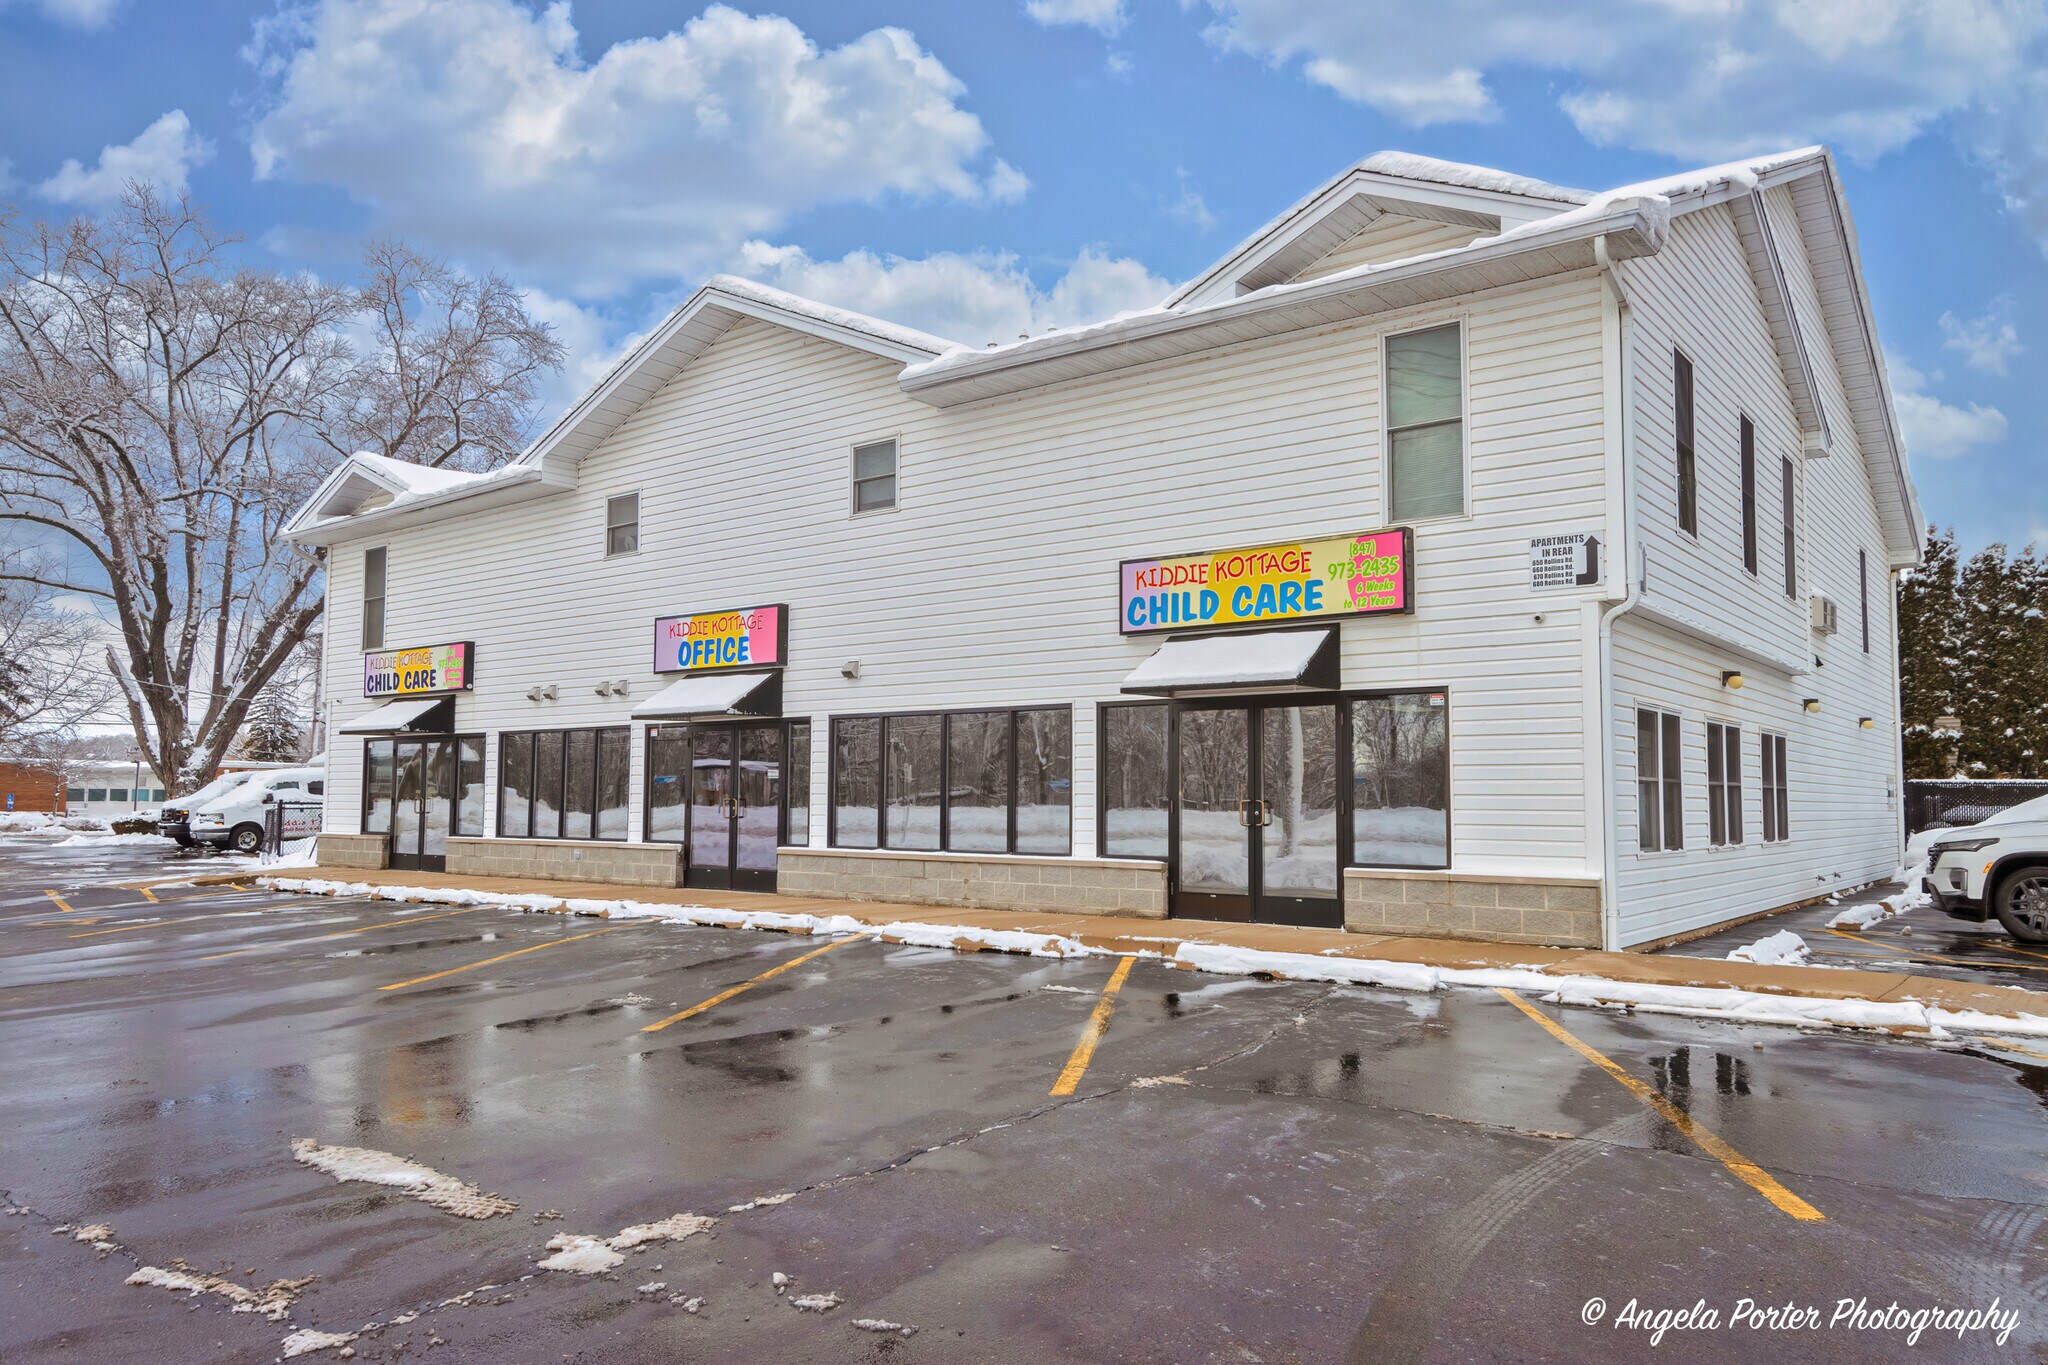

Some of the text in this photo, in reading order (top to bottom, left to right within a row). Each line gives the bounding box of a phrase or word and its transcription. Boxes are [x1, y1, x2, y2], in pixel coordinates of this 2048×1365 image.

[1349, 540, 1376, 558] (847)
[1531, 534, 1584, 548] APARTMENTS
[1542, 547, 1573, 557] IN REAR
[1544, 557, 1564, 565] Rollins
[1135, 551, 1312, 591] KIDDIE KOTTAGE
[1328, 555, 1399, 582] 973-2435
[1356, 578, 1394, 594] 6 Weeks
[1127, 579, 1324, 627] CHILD CARE
[1343, 594, 1395, 609] to 12 Years
[669, 614, 763, 639] KIDDIE KOTTAGE
[370, 656, 397, 671] KIDDIE
[398, 651, 434, 668] KOTTAGE
[678, 636, 750, 666] OFFICE
[367, 669, 437, 693] CHILD CARE
